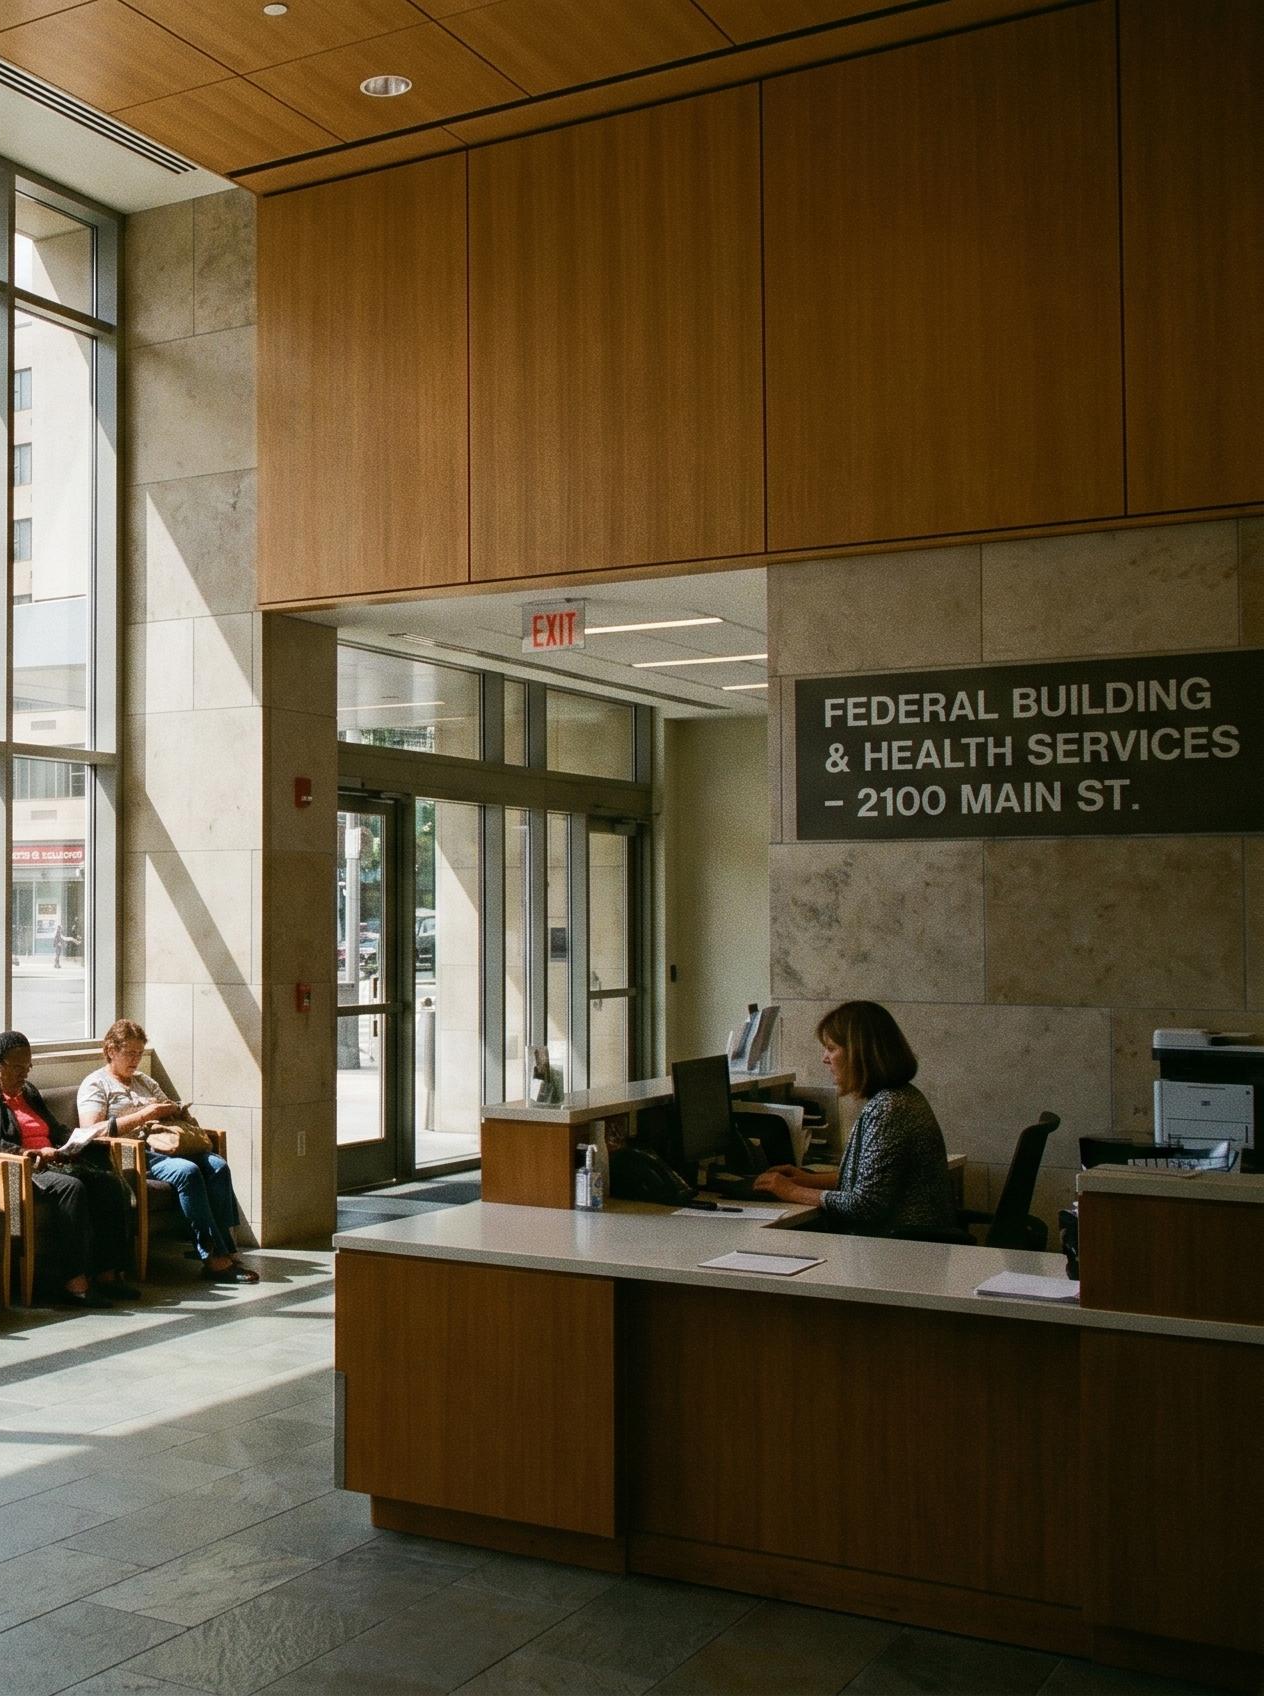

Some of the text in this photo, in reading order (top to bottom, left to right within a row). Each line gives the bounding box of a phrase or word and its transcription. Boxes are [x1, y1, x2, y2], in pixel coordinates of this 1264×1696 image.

[532, 612, 576, 648] EXIT
[823, 676, 1213, 728] FEDERAL BUILDING
[824, 724, 1241, 774] & HEALTH SERVICES
[856, 785, 947, 818] 2100
[959, 780, 1062, 815] MAIN
[1076, 778, 1141, 812] ST.
